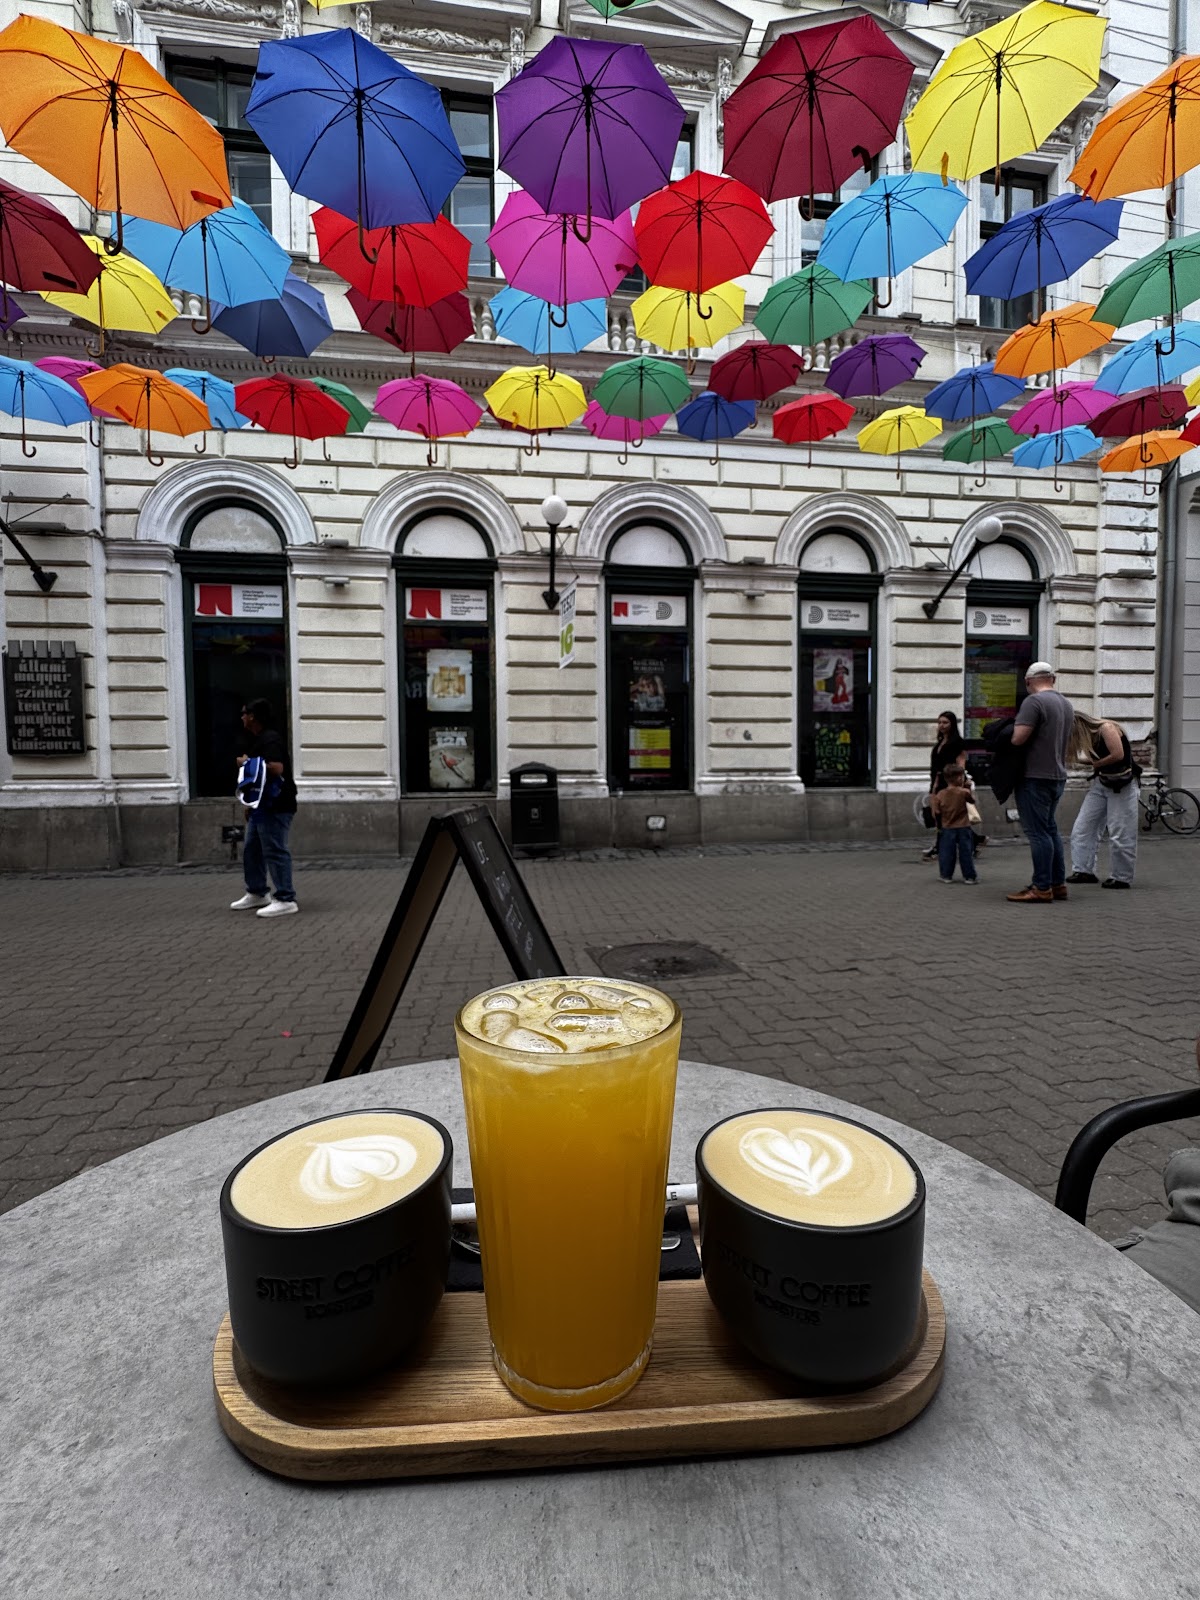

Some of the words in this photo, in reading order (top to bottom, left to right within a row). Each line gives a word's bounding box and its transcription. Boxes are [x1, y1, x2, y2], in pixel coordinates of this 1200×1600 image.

[18, 699, 70, 712] teatrul
[14, 712, 75, 728] maghiar
[18, 724, 35, 737] de
[43, 725, 72, 737] stat
[256, 1274, 326, 1302] STREET
[780, 1276, 872, 1308] COFFEE
